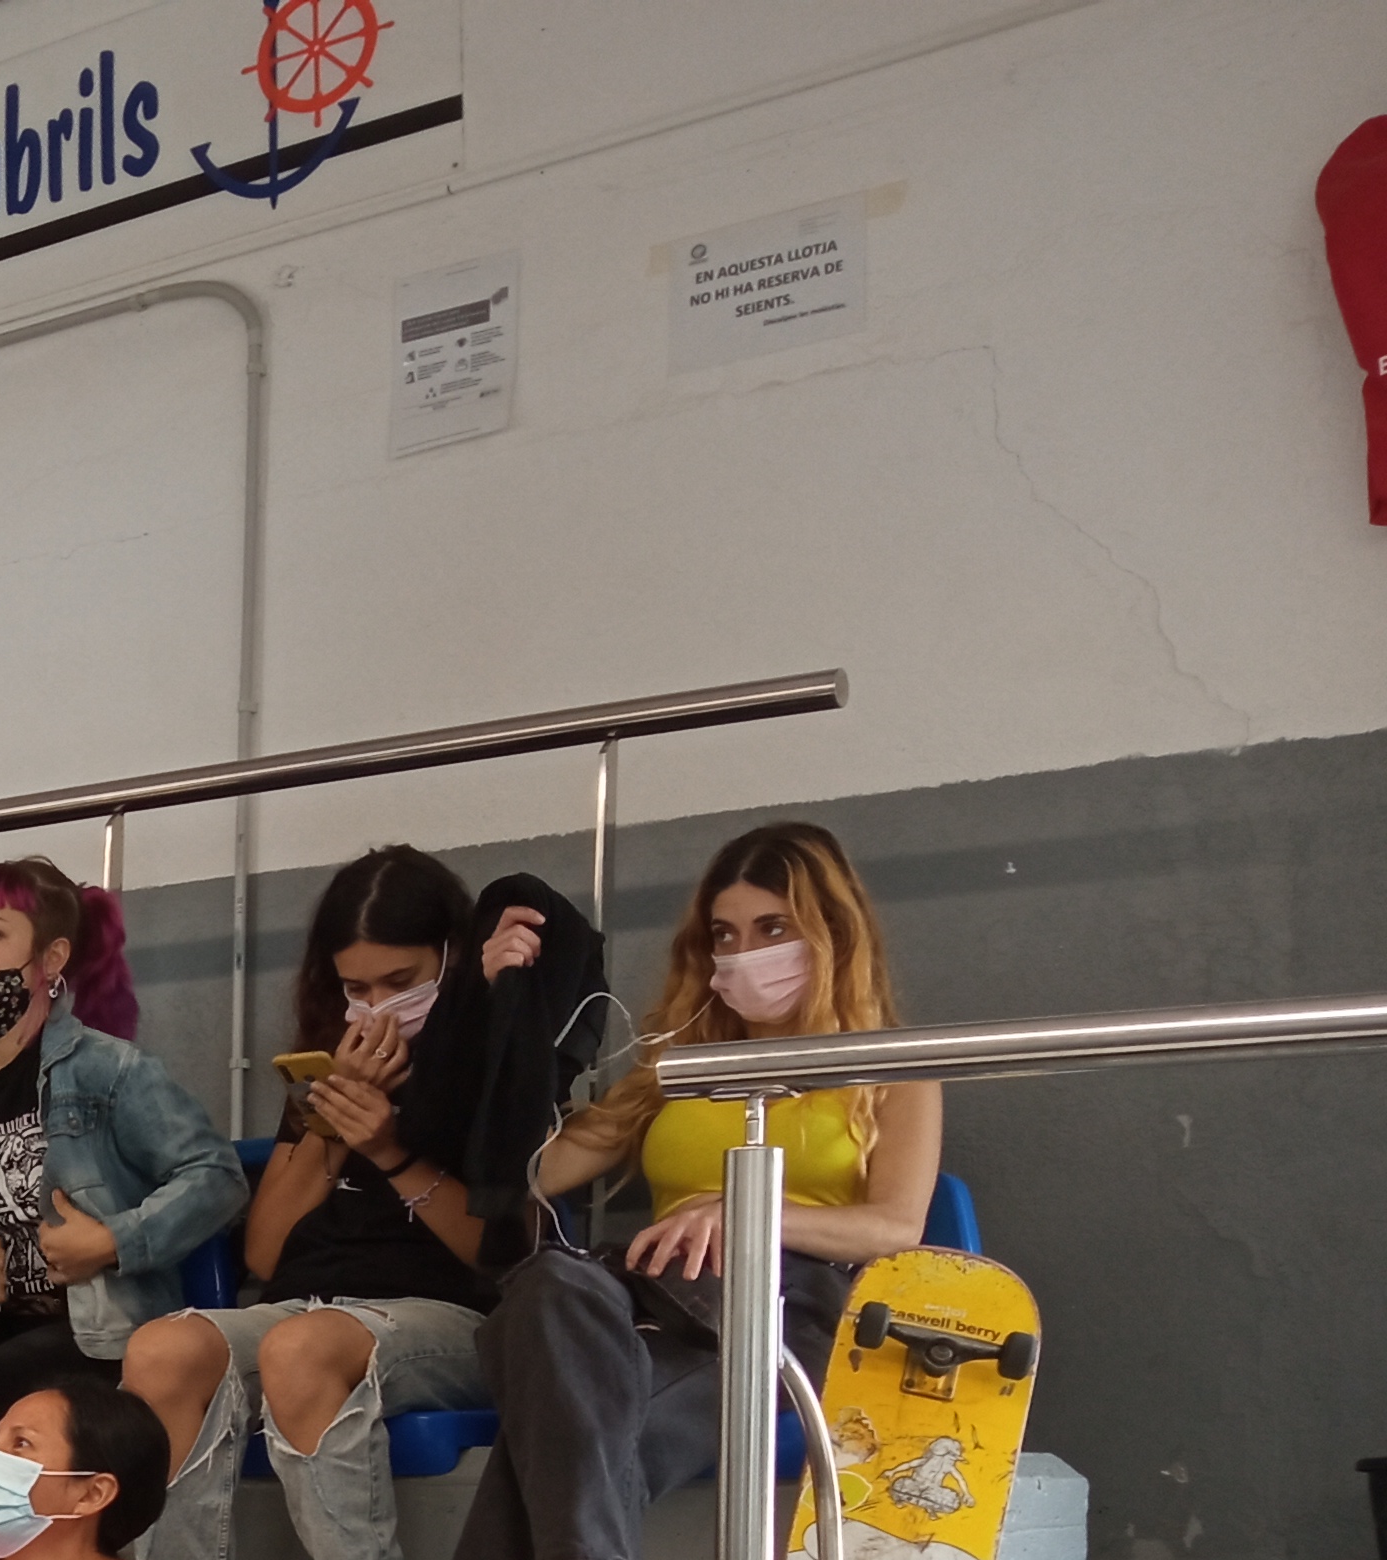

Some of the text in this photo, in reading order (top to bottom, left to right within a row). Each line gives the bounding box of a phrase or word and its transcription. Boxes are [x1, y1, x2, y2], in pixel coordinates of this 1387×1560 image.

[695, 240, 838, 284] EN AQUESTA LLOTJA
[690, 259, 844, 307] NO HI HA RESERVA DE
[735, 293, 795, 318] SEIENTS.
[955, 1320, 1001, 1342] berry
